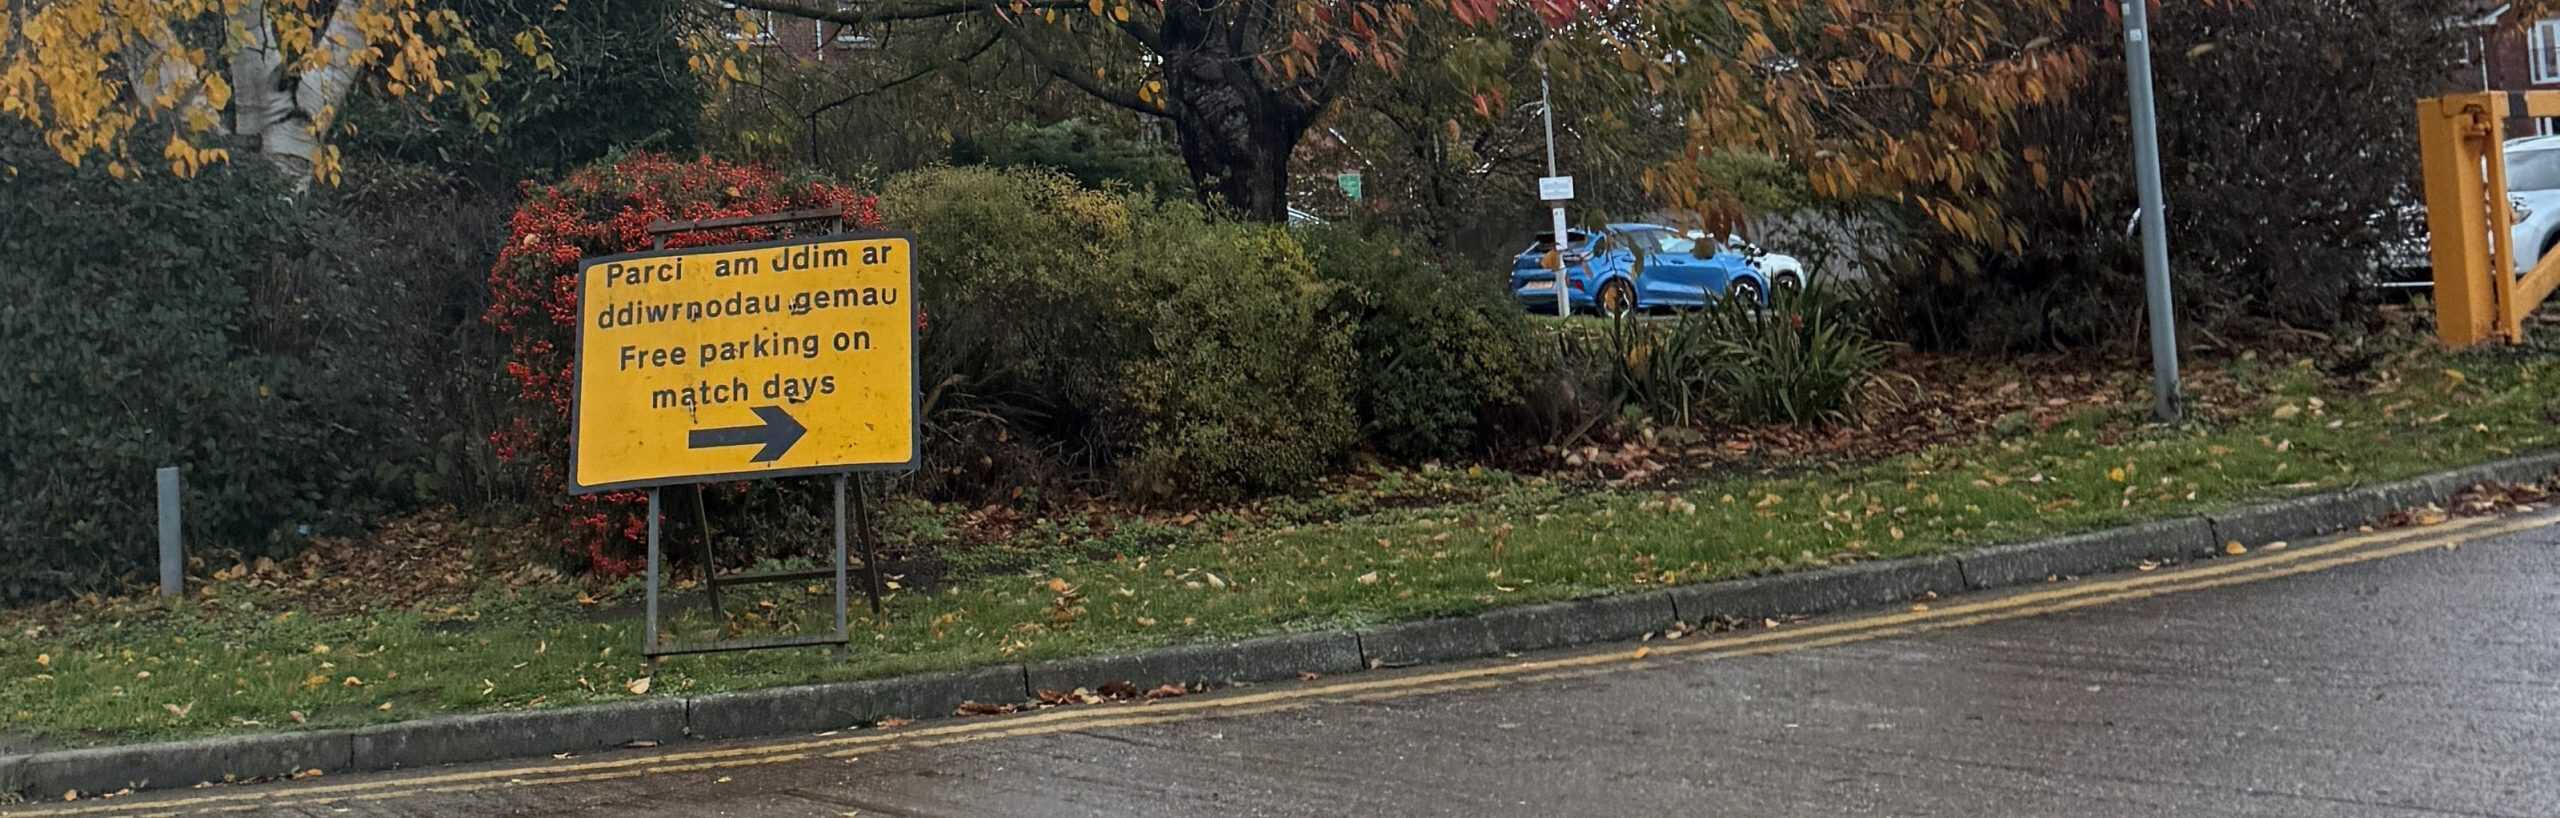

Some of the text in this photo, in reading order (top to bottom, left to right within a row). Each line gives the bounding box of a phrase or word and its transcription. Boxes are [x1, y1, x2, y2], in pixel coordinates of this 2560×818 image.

[715, 256, 759, 277] am
[862, 245, 892, 265] ar
[598, 286, 897, 329] ddiwrnodau gemau
[620, 331, 870, 371] Free parking on
[652, 373, 836, 409] match days
